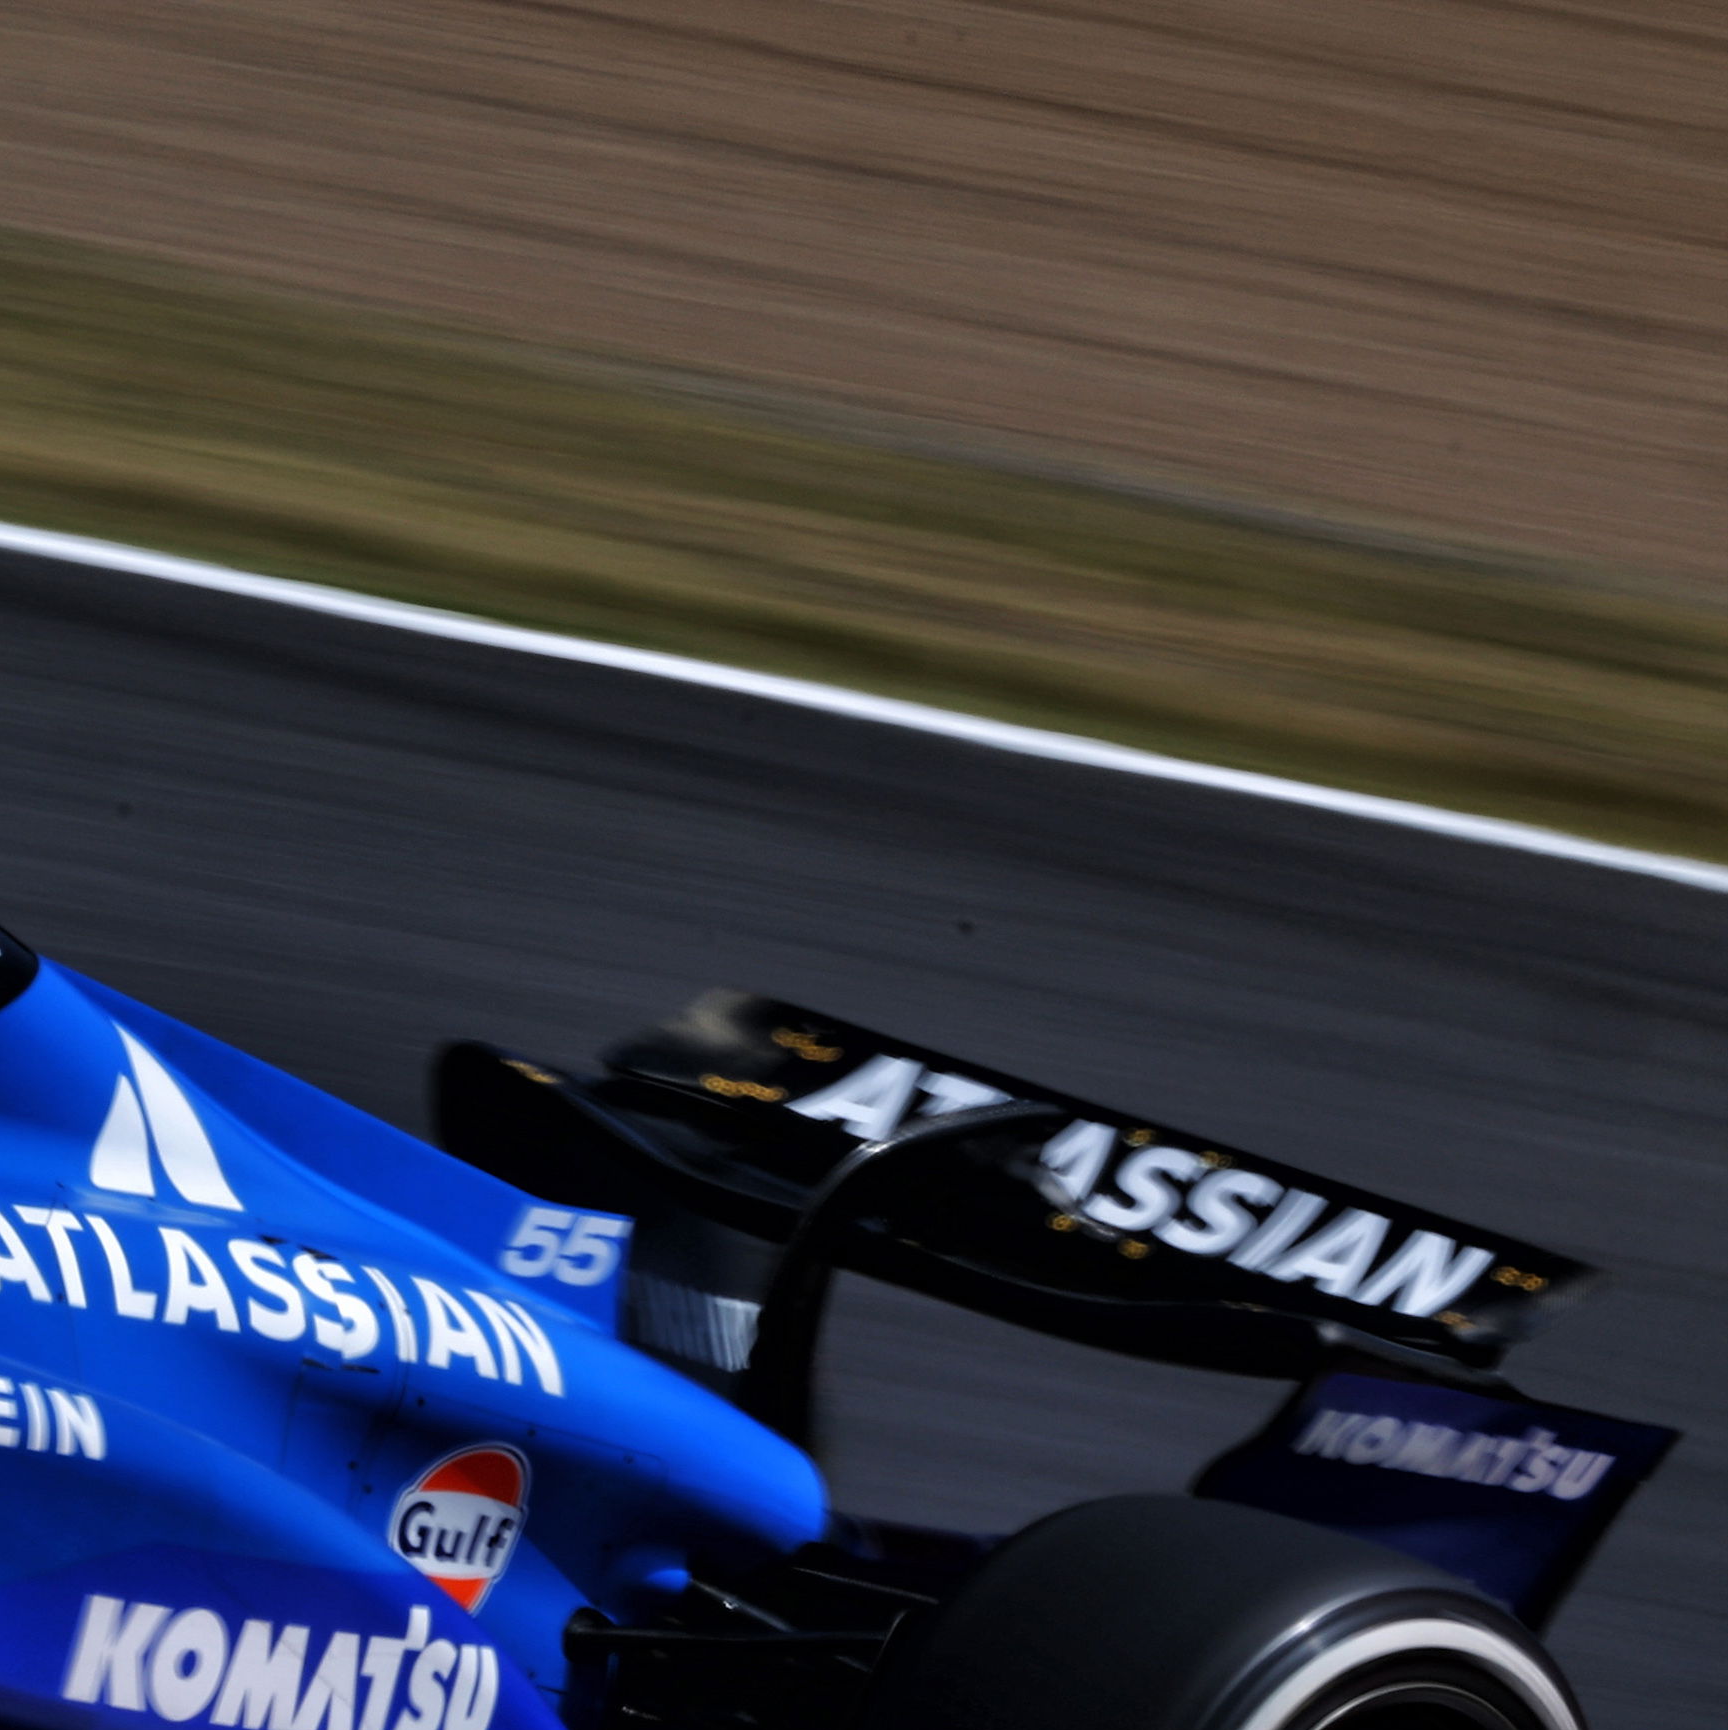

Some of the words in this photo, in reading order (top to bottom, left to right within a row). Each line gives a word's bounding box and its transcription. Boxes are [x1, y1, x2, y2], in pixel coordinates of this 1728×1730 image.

[784, 1054, 1493, 1317] ATASSIAN
[499, 1206, 635, 1287] 55
[1299, 1405, 1616, 1503] KOMATSU
[399, 1501, 516, 1568] Gulf
